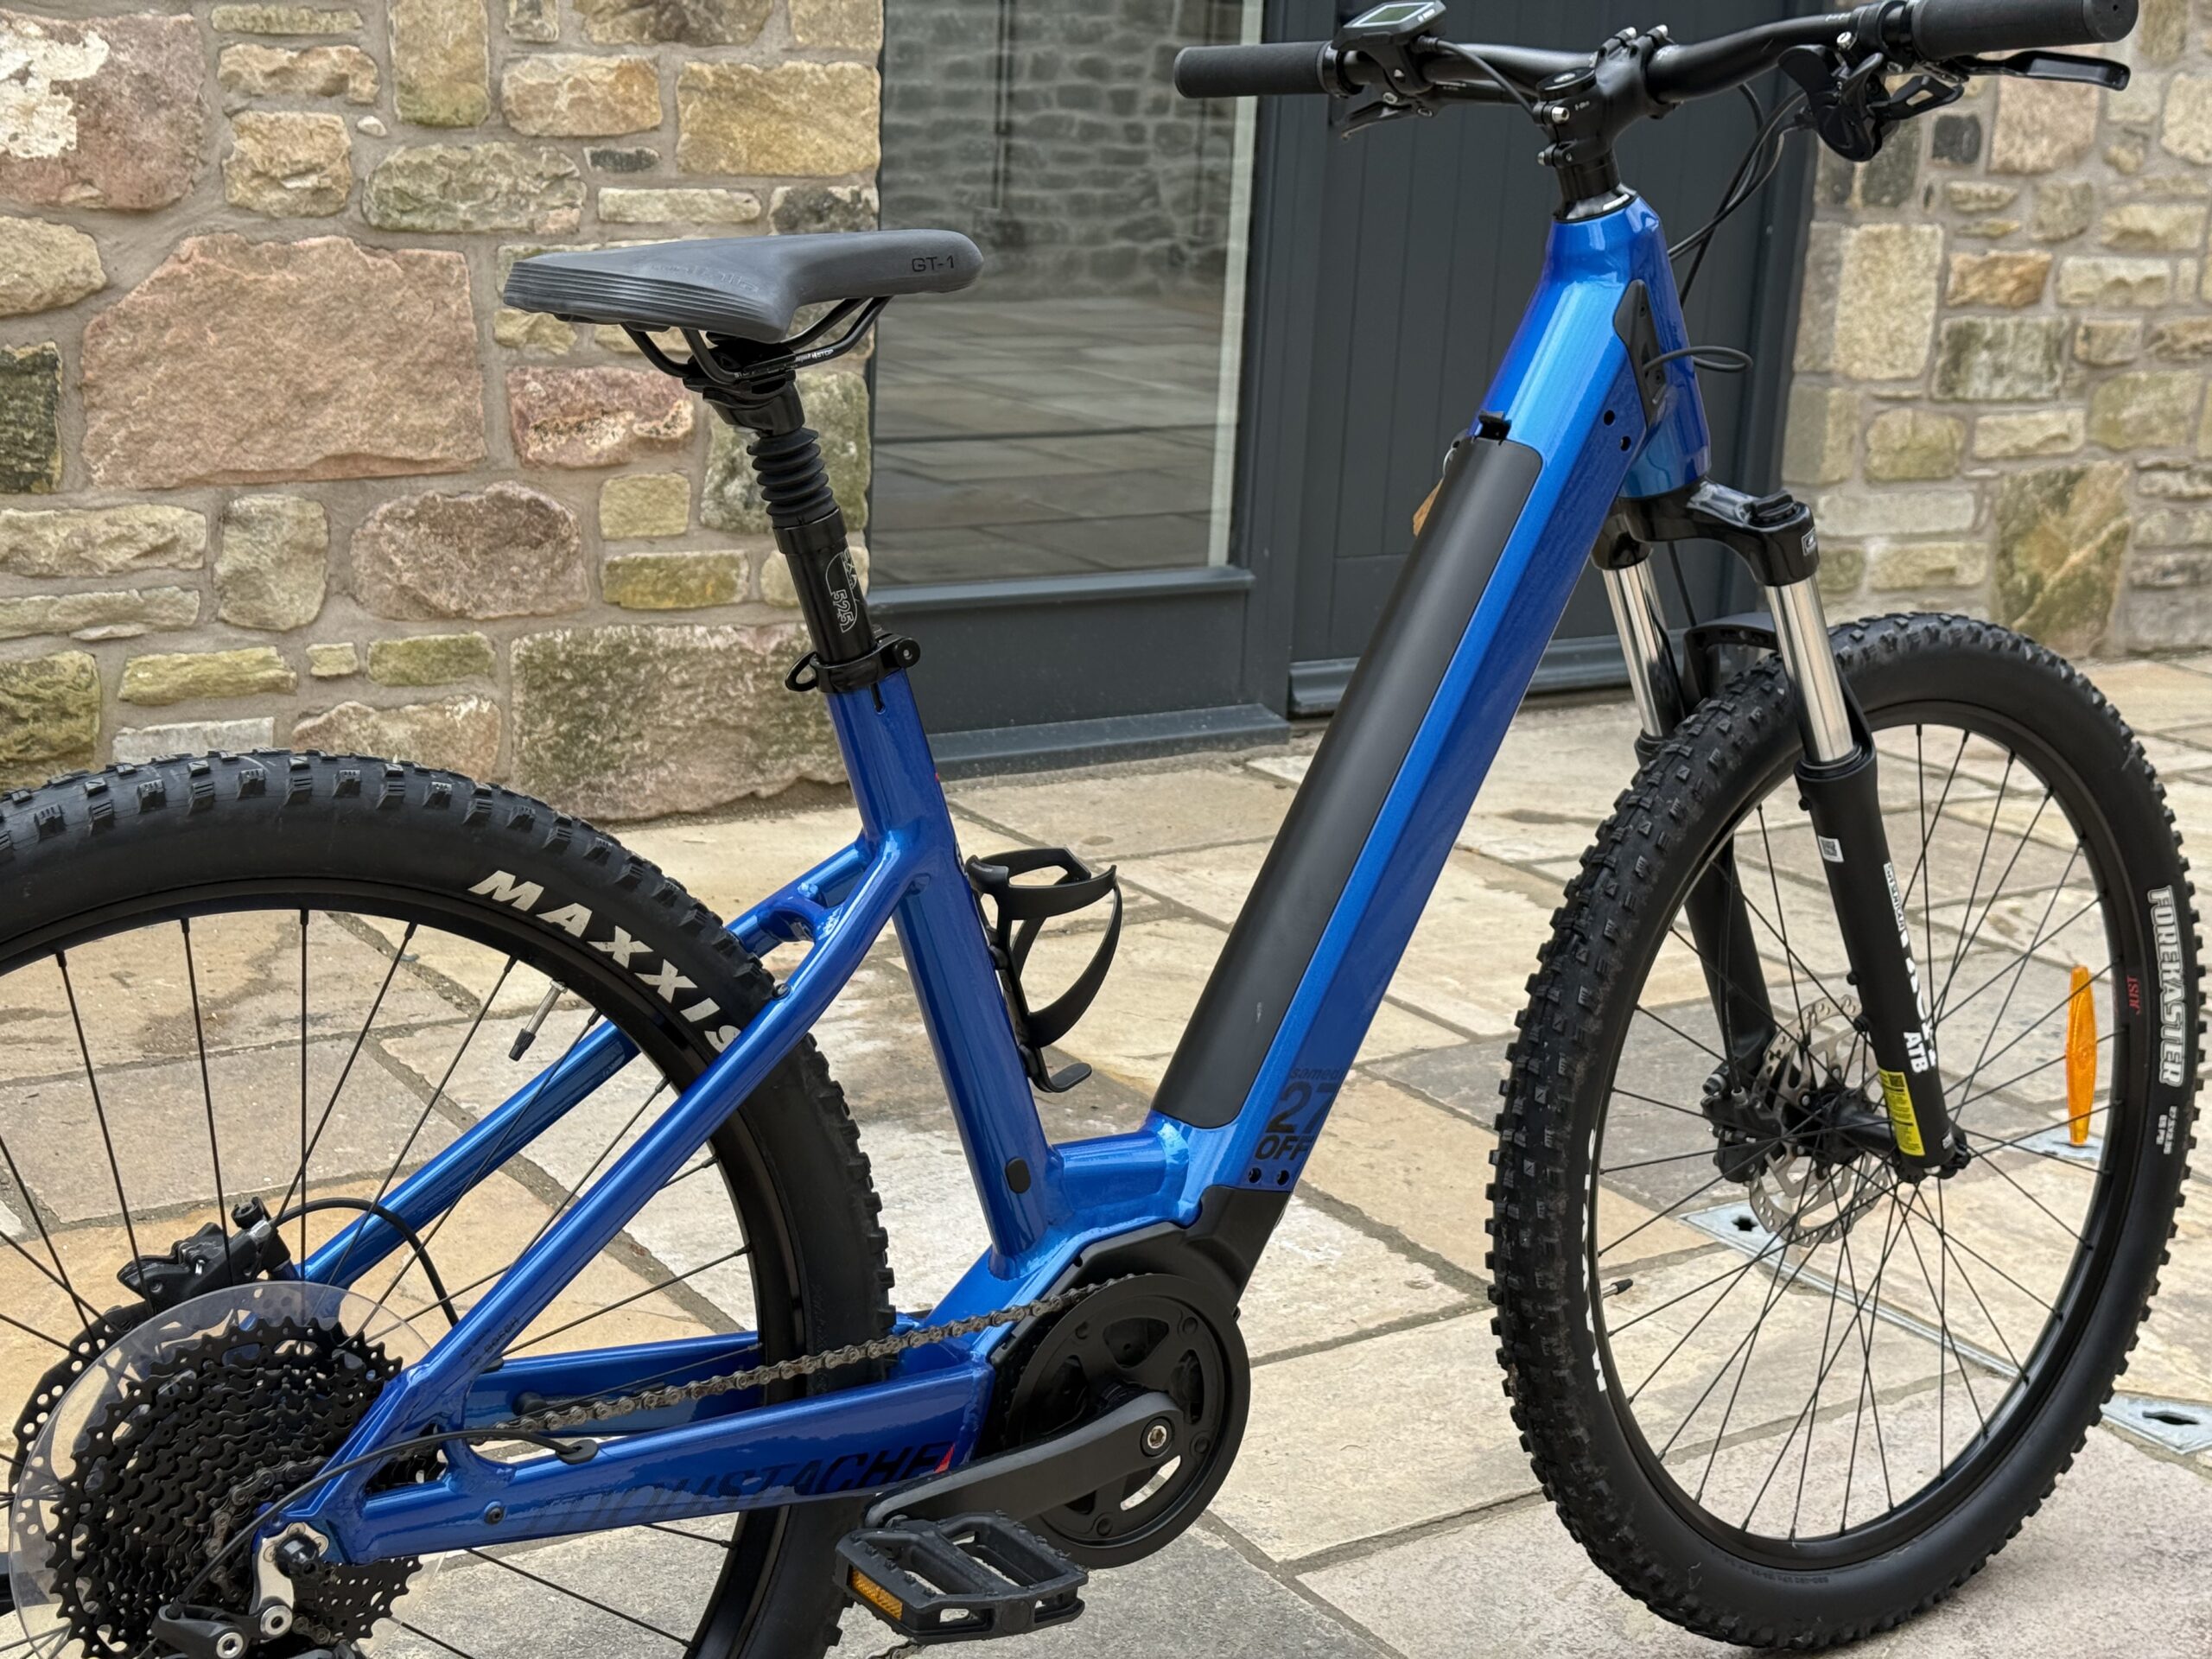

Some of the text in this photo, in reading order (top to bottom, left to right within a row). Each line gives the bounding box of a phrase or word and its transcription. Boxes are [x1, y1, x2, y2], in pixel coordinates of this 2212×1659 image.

[912, 256, 954, 272] GT-1
[467, 870, 741, 1053] MAXXIS
[2147, 886, 2185, 1087] FOREKASTER
[1904, 1032, 1929, 1073] ATB
[1265, 1082, 1338, 1134] 27
[1255, 1135, 1313, 1160] OFF
